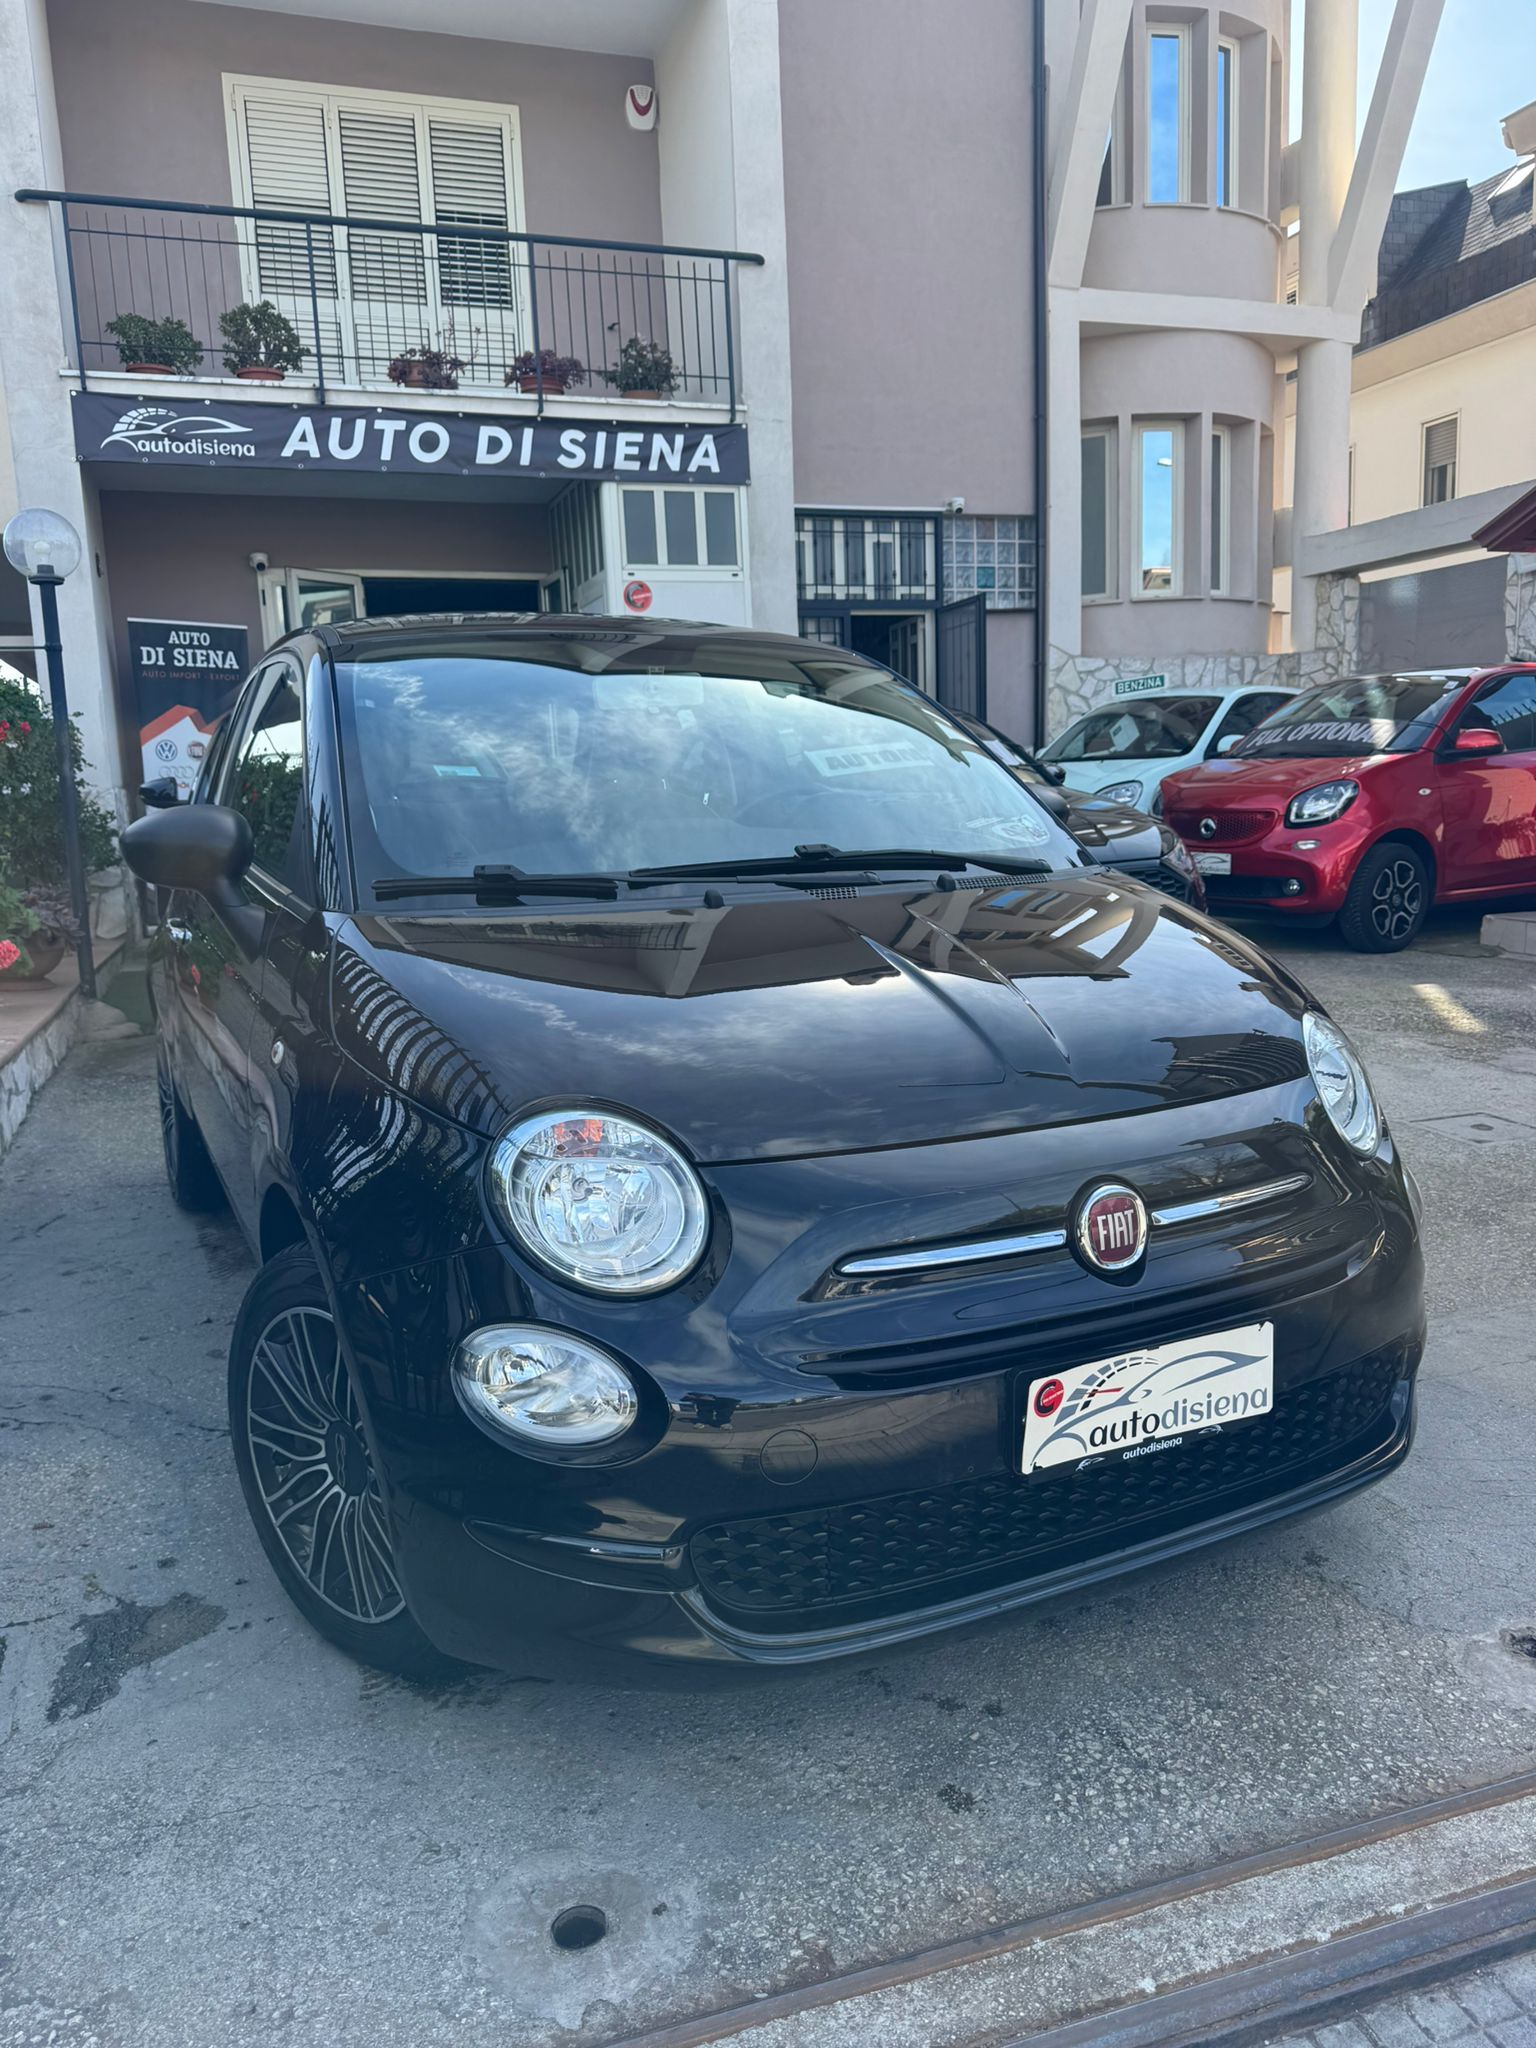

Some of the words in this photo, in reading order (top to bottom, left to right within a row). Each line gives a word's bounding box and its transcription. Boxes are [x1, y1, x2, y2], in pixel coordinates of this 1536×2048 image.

[137, 437, 256, 457] autodisiena
[280, 416, 450, 463] AUTO
[475, 425, 534, 466] DI
[556, 428, 721, 473] SIENA
[168, 630, 211, 646] AUTO
[140, 646, 166, 666] DI
[173, 648, 240, 670] SIENA
[142, 670, 167, 679] AUTO
[169, 671, 201, 680] IMPORT
[1117, 676, 1163, 693] BENZINA
[1246, 725, 1290, 748] FULL
[1096, 1208, 1135, 1252] FIAT
[1089, 1387, 1268, 1449] autodisiena
[1122, 1436, 1183, 1460] autodisiena
